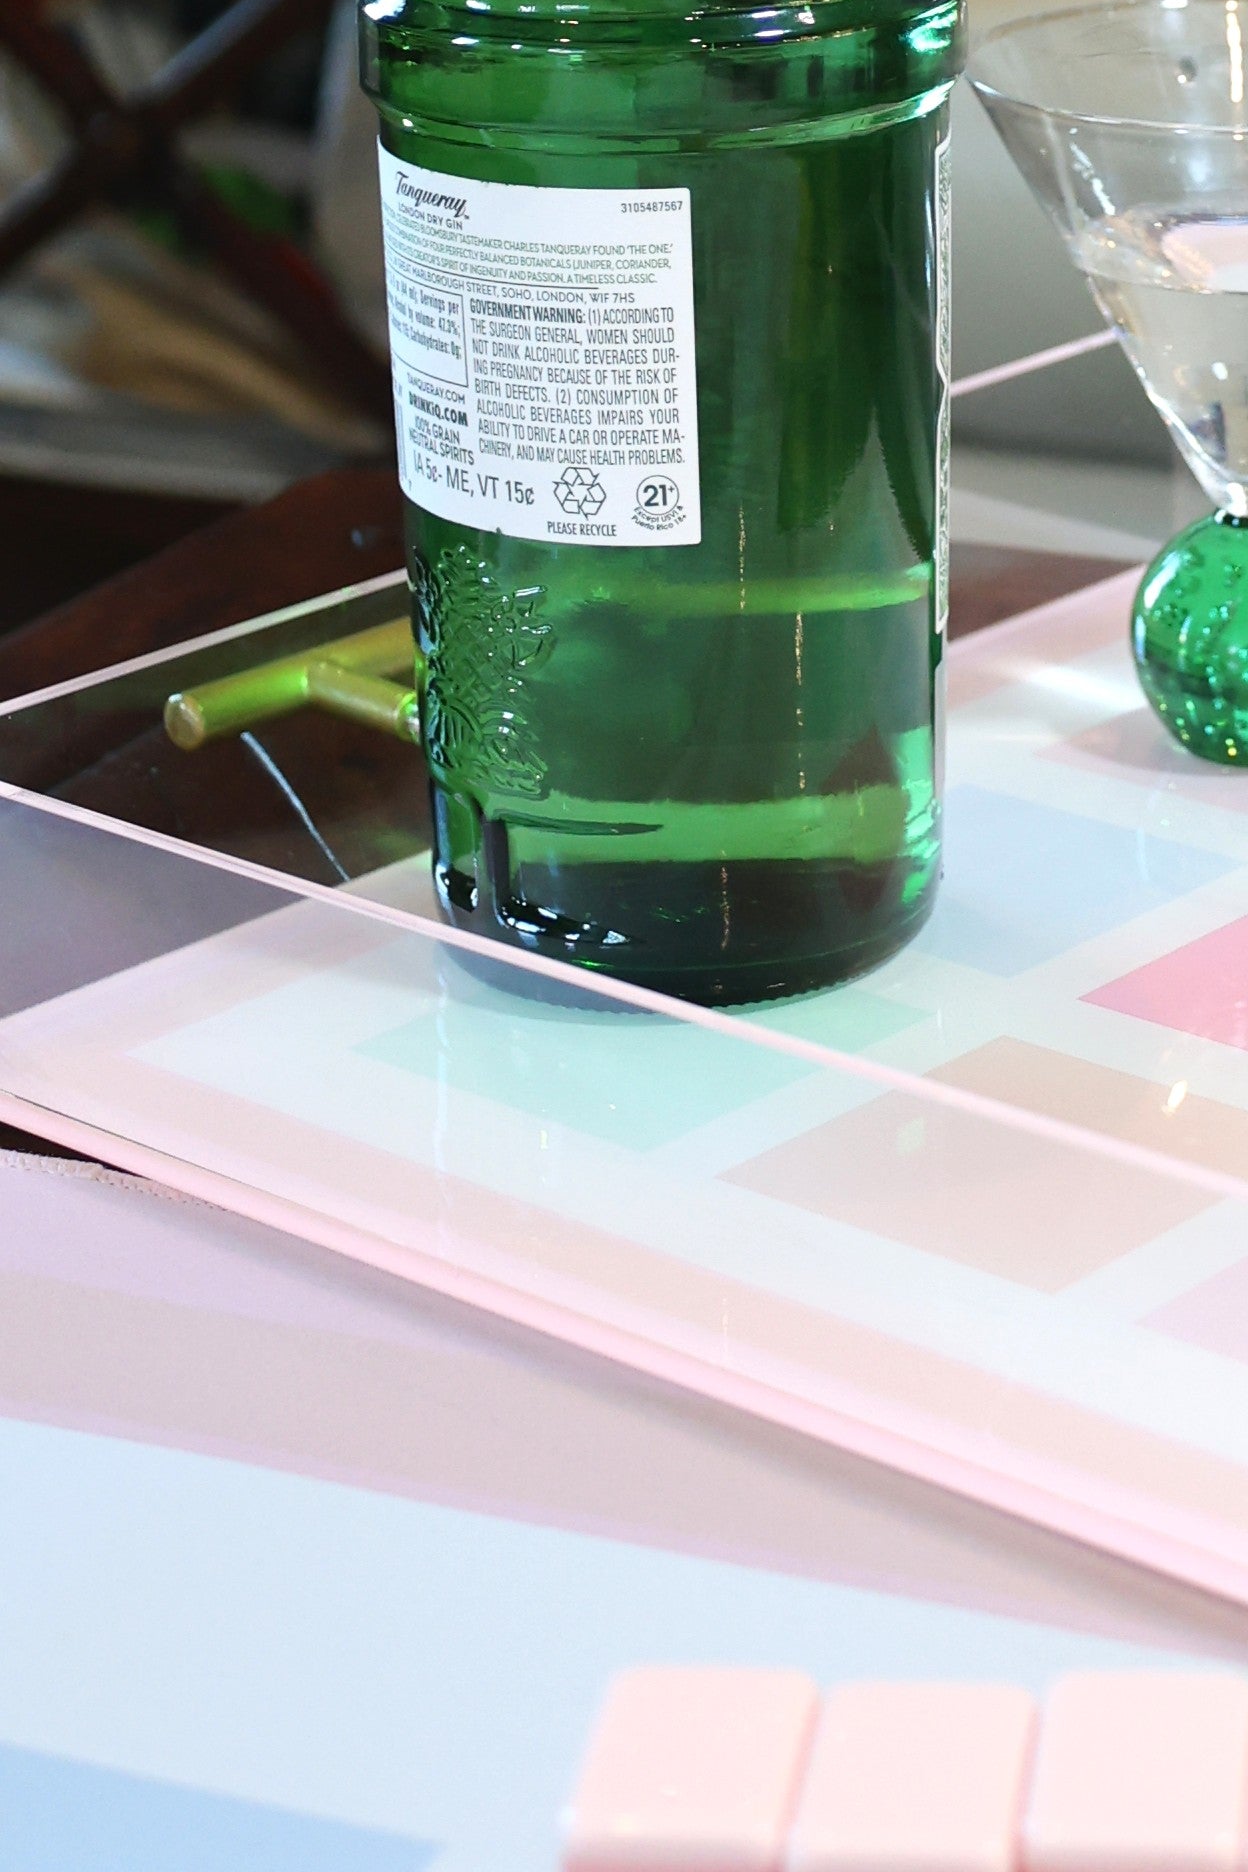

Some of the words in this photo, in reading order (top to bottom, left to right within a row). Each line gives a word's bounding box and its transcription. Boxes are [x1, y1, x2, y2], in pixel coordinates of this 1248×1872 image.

[396, 171, 467, 219] Tanqueray
[621, 201, 683, 213] 3105487567
[427, 213, 443, 226] DRY
[446, 219, 463, 231] GIN
[480, 250, 519, 265] BALANCED
[521, 255, 571, 269] BOTANICALS
[615, 259, 671, 270] CORIANDER,
[504, 240, 539, 253] CHARLES
[541, 243, 591, 255] TANQUERAY
[593, 245, 625, 256] FOUND
[509, 269, 526, 280] AND
[575, 273, 615, 284] TIMELESS
[616, 273, 657, 284] CLASSIC.
[467, 282, 500, 298] STREET,
[502, 286, 533, 301] SOHO,
[536, 291, 587, 304] LONDON,
[613, 293, 635, 303] 7HS
[470, 298, 531, 320] GOVERNMENT
[532, 306, 586, 324] WARNING:
[588, 309, 600, 325] (1)
[602, 308, 660, 324] ACCORDING
[661, 307, 674, 322] TO
[471, 317, 486, 335] THE
[489, 320, 531, 341] SURGEON
[535, 326, 583, 345] GENERAL,
[586, 329, 628, 345] WOMEN
[633, 328, 674, 344] SHOULD
[472, 338, 488, 355] NOT
[492, 341, 520, 360] DRINK
[524, 345, 580, 364] ALCOHOLIC
[584, 348, 647, 365] BEVERAGES
[653, 348, 680, 364] DUR-
[473, 358, 488, 376] ING
[490, 361, 543, 383] PREGNANCY
[547, 367, 591, 385] BECAUSE
[595, 369, 608, 385] OF
[612, 369, 631, 385] THE
[636, 369, 661, 384] RISK
[663, 368, 677, 384] OF
[475, 378, 501, 397] BIRTH
[505, 383, 551, 402] DEFECTS.
[555, 388, 571, 406] (2)
[576, 389, 659, 405] CONSUMPTION
[664, 388, 678, 404] OF
[477, 398, 526, 420] ALCOHOLIC
[530, 406, 592, 425] BEVERAGES
[597, 409, 644, 425] IMPAIRS
[649, 409, 679, 424] YOUR
[432, 424, 460, 444] GRAIN
[478, 418, 510, 438] ABILITY
[513, 423, 524, 441] TO
[527, 426, 556, 443] DRIVE
[559, 428, 566, 444] A
[569, 429, 590, 445] CAR
[593, 429, 607, 445] OR
[611, 429, 659, 445] OPERATE
[663, 429, 685, 444] MA-
[440, 442, 474, 465] SPIRITS
[479, 437, 514, 460] CHINERY,
[516, 444, 534, 461] AND
[537, 446, 555, 463] MAY
[557, 448, 587, 465] CAUSE
[590, 450, 625, 465] HEALTH
[628, 448, 686, 465] PROBLEMS.
[446, 465, 474, 497] ME,
[477, 473, 499, 499] VT
[547, 521, 577, 536] PLEASE
[580, 523, 617, 536] RECYCLE
